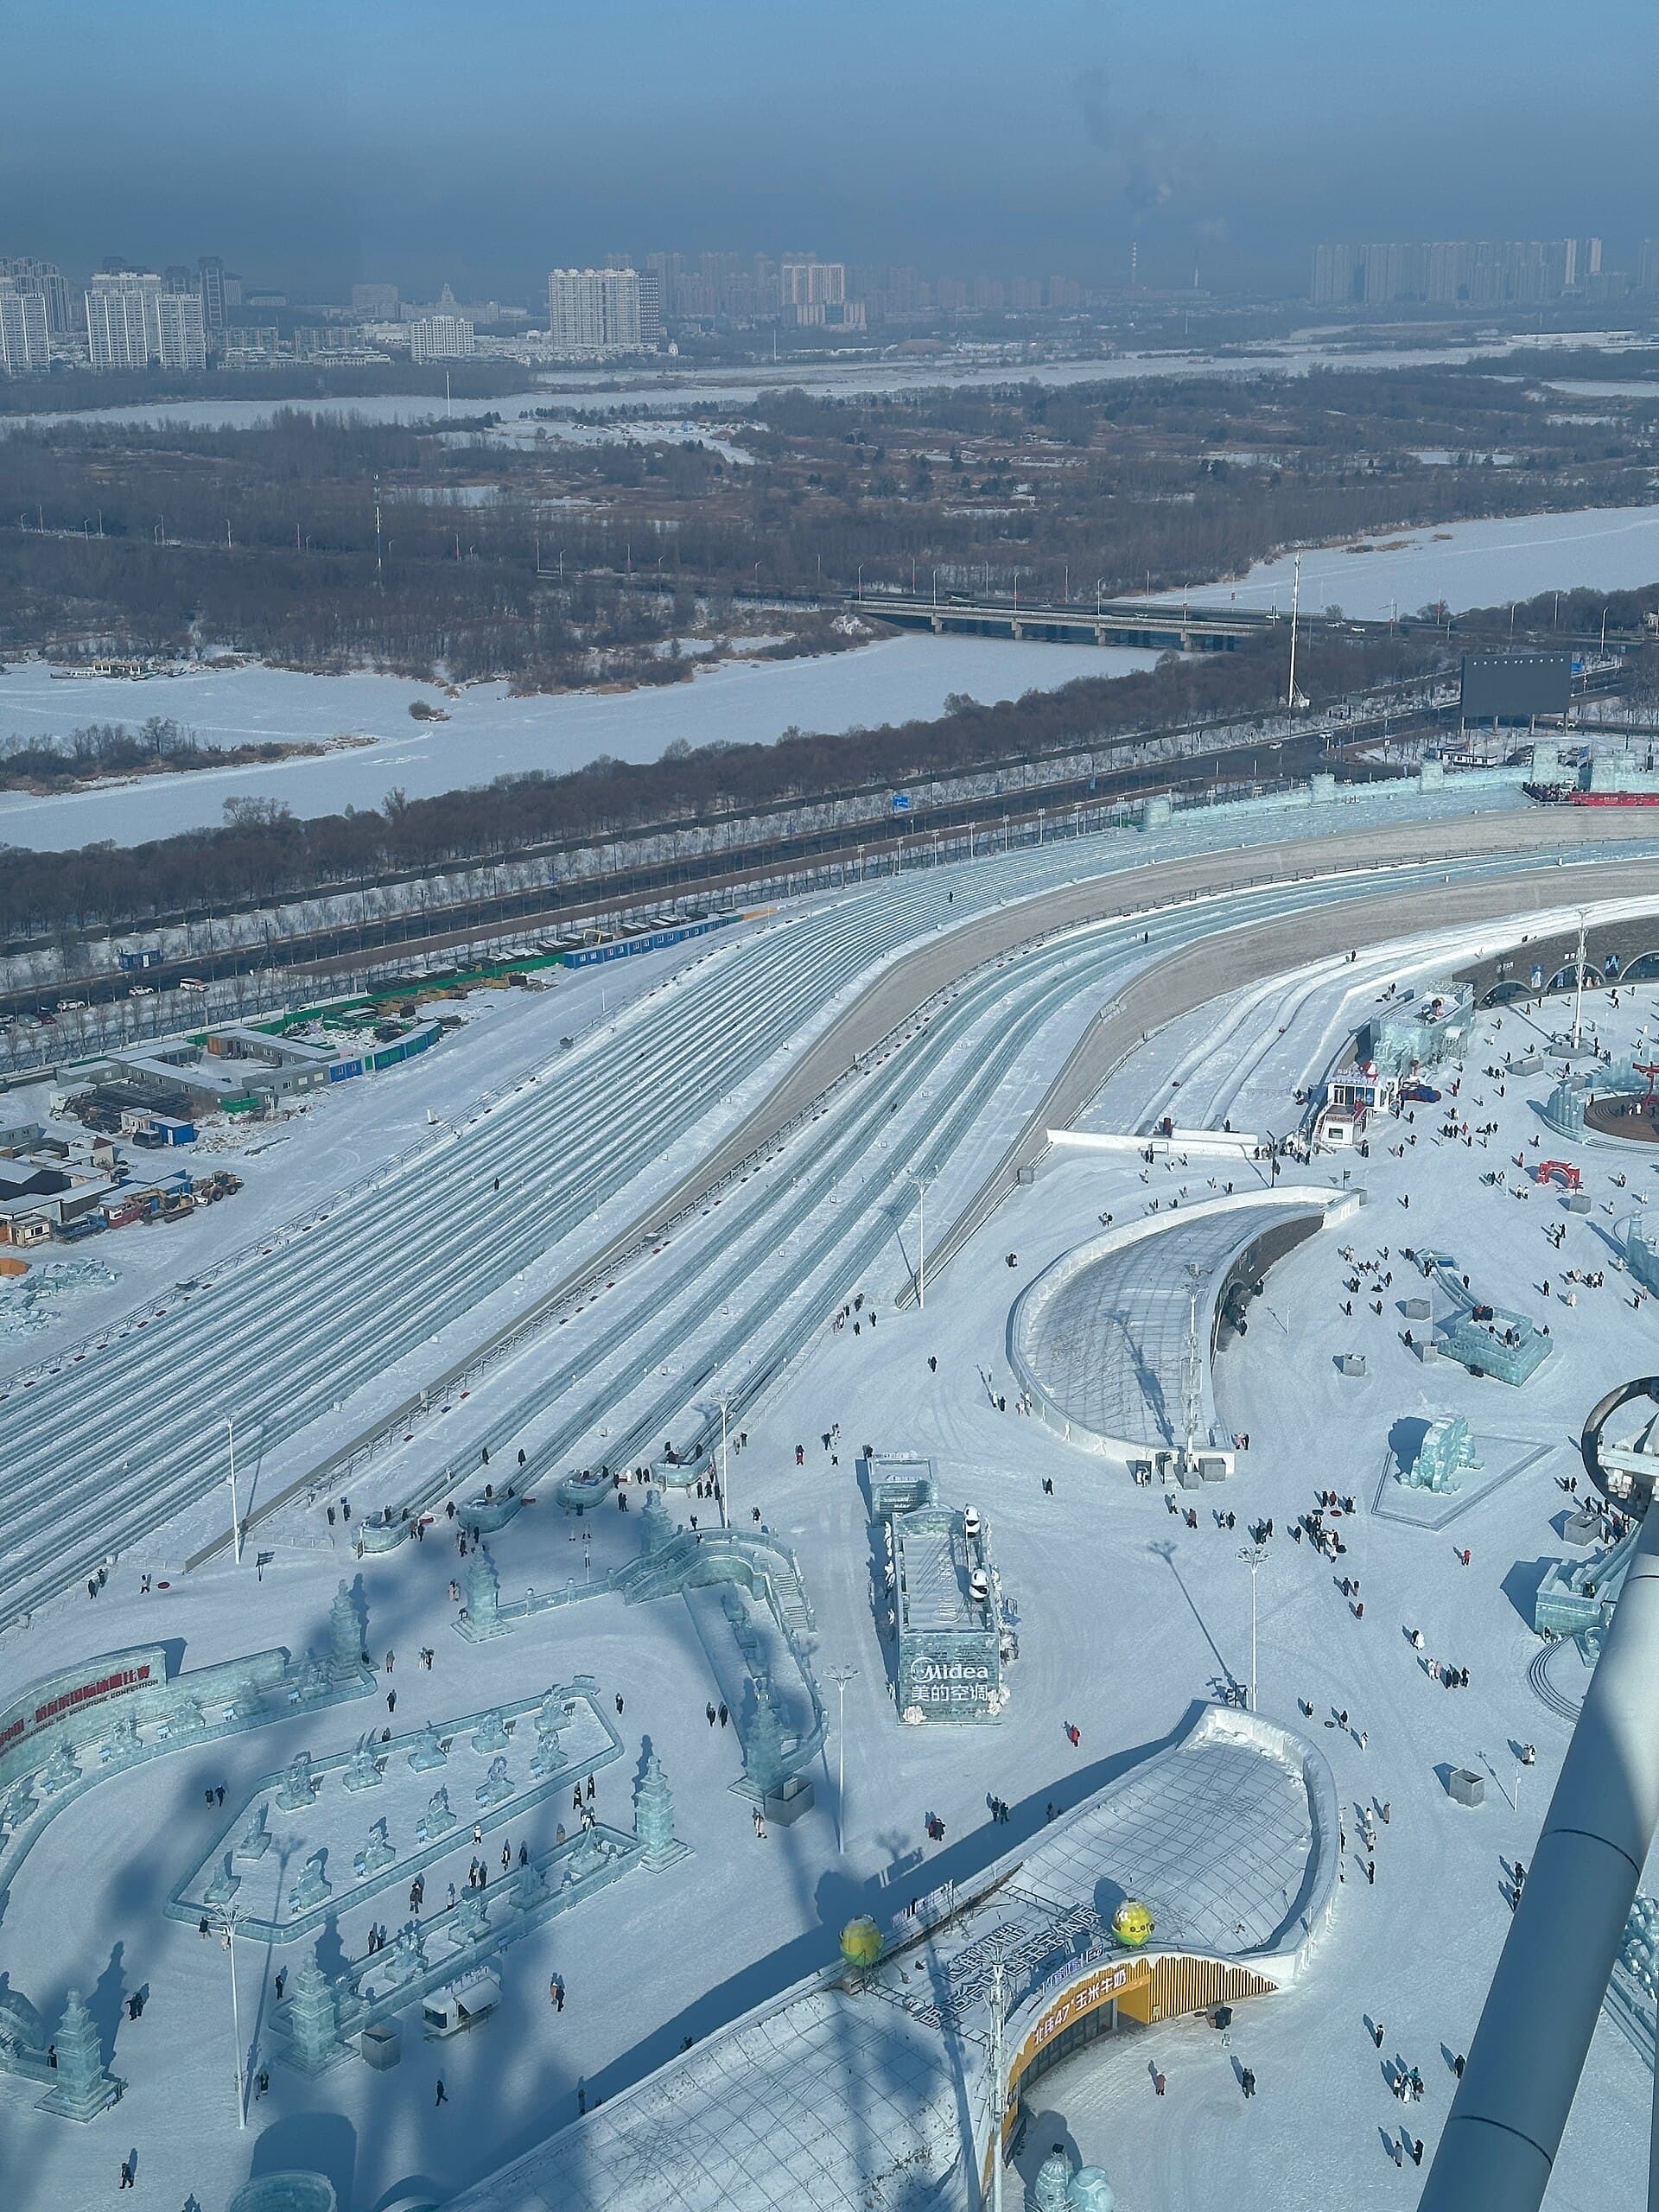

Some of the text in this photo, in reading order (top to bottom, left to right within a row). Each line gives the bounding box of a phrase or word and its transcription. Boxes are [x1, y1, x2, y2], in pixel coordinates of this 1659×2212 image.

[914, 1660, 988, 1681] Midea
[911, 1684, 988, 1701] 美的空调
